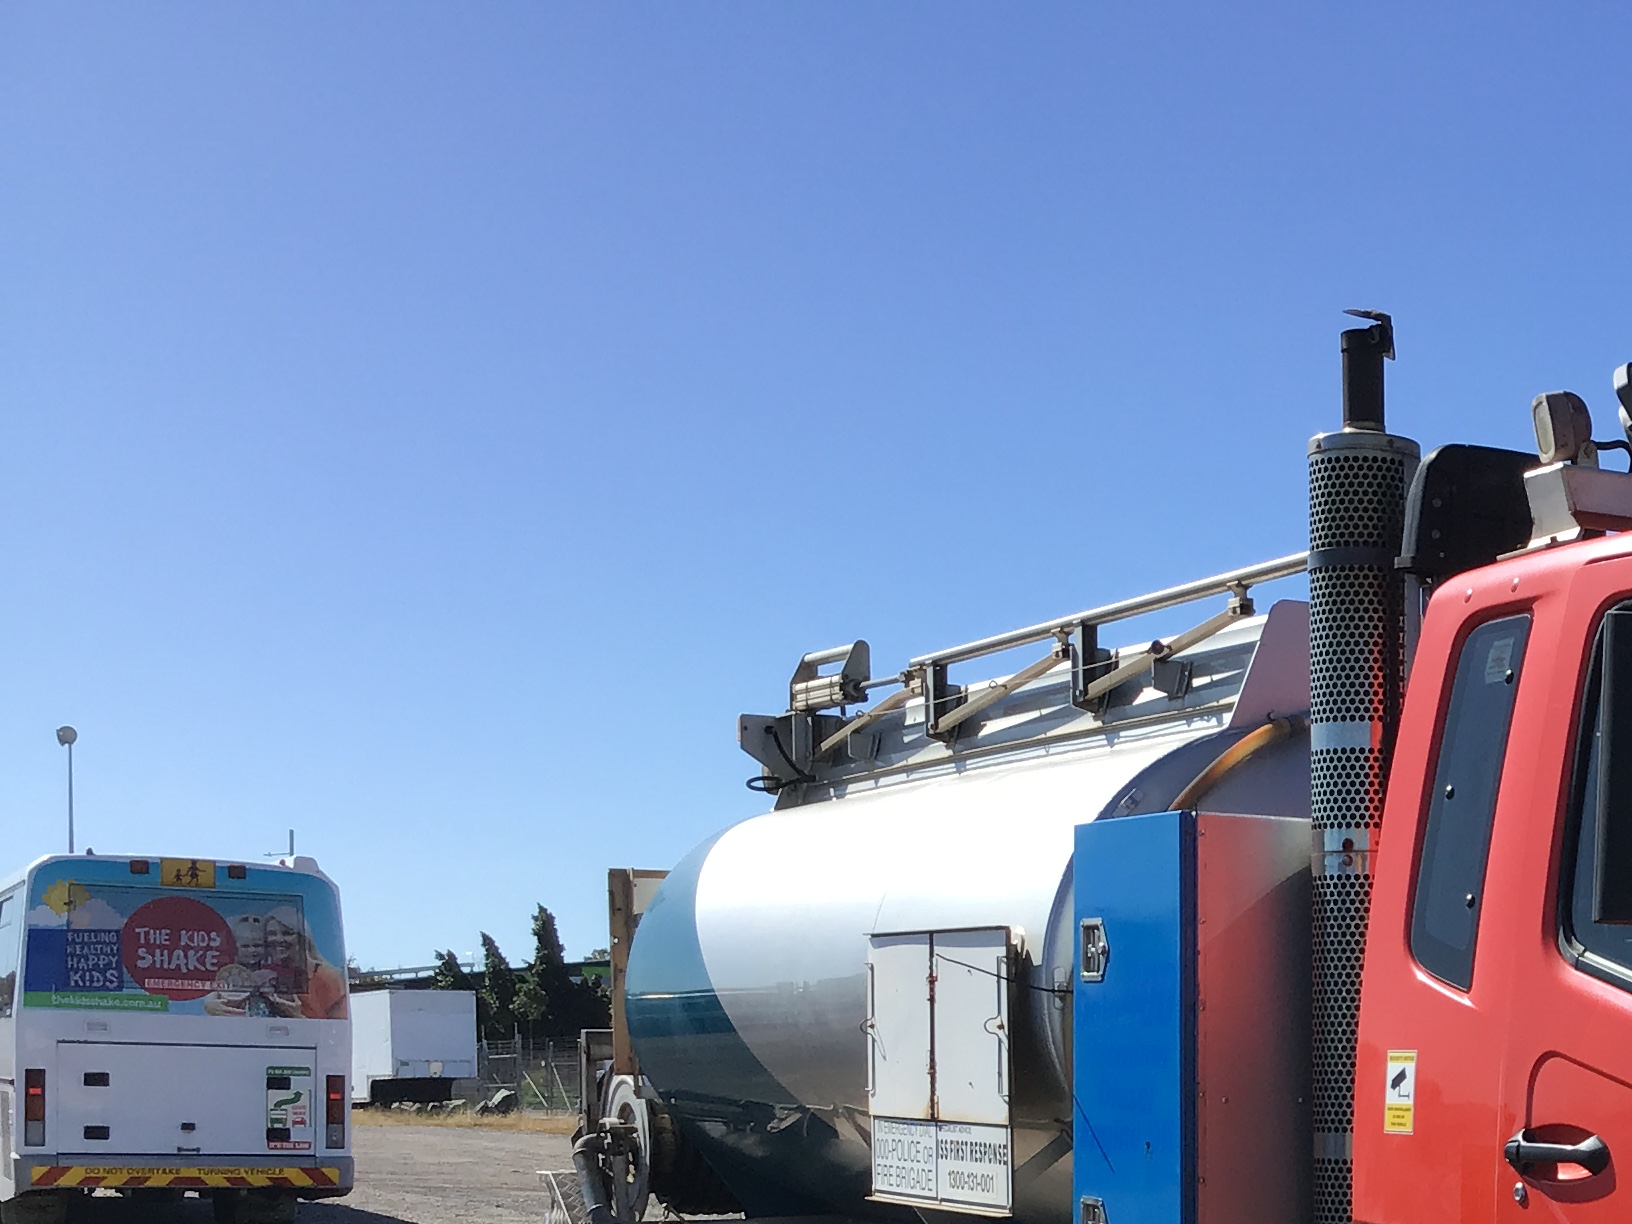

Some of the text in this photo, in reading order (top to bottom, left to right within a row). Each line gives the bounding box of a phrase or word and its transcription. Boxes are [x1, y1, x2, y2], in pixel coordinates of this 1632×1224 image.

[67, 931, 118, 943] FUELING
[135, 927, 221, 947] THE KIDS
[66, 944, 119, 954] HEALTHY
[67, 955, 119, 969] HAPPY
[136, 948, 221, 973] SHAKE
[69, 970, 119, 989] KIDS
[950, 1140, 969, 1162] FIRST
[970, 1141, 1008, 1166] RESPONSE
[85, 1168, 285, 1176] DO NOT OVERTAKE TURNING VEHICLE
[877, 1163, 933, 1192] FIRE BRIGADE
[948, 1169, 995, 1194] 1300-131-001
